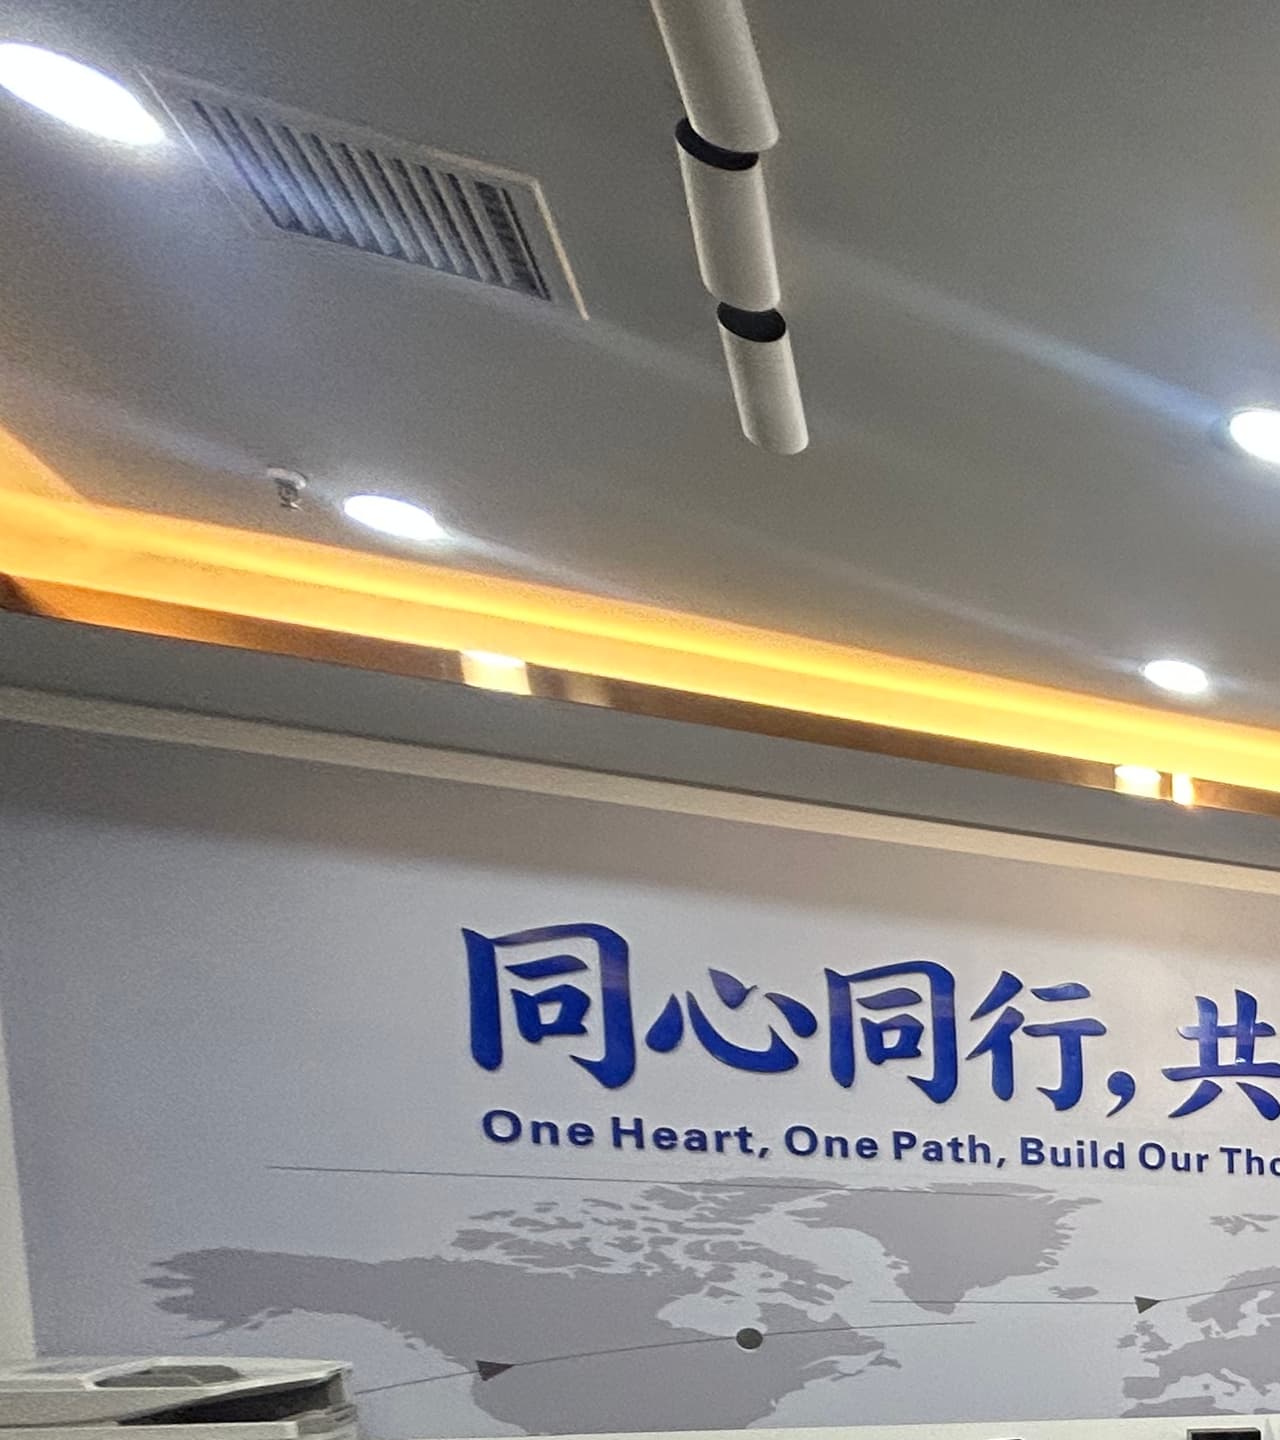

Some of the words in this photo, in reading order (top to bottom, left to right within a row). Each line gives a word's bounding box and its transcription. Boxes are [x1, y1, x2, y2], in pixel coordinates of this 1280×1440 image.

[481, 1109, 595, 1146] One
[610, 1116, 770, 1158] Heart,
[784, 1125, 878, 1160] One
[892, 1131, 1006, 1168] Path,
[1020, 1136, 1126, 1170] Build
[1138, 1142, 1209, 1173] Our
